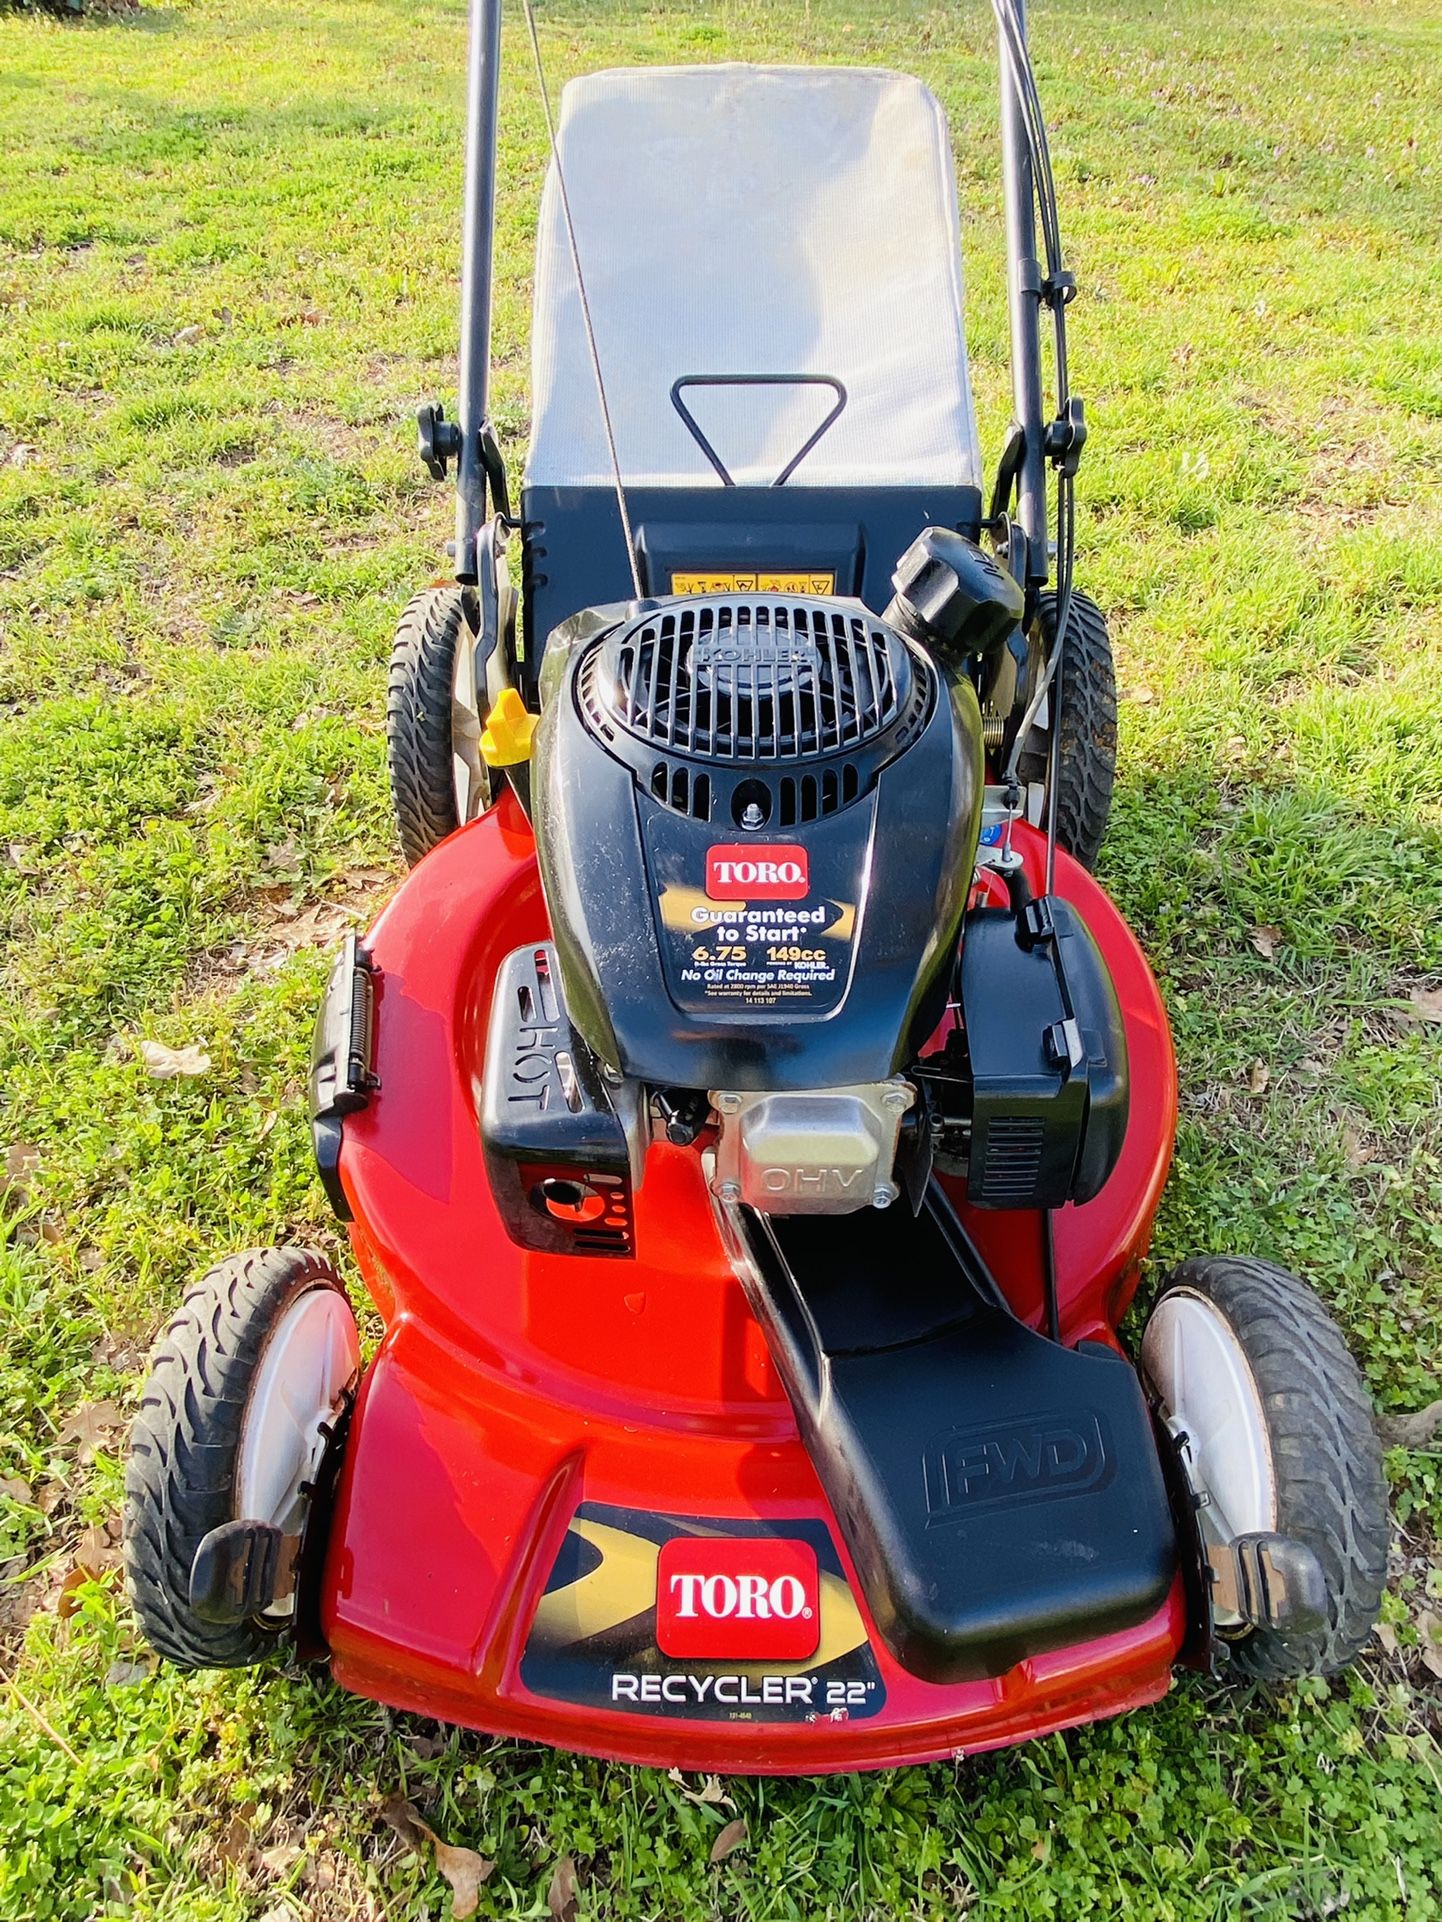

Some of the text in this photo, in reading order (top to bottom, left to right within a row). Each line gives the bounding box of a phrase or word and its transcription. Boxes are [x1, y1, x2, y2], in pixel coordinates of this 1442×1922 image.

[691, 906, 826, 924] Guaranteed
[717, 927, 739, 941] to
[692, 946, 826, 961] 6.75 149cc
[681, 968, 835, 983] No Oil Change Required
[507, 1026, 559, 1111] HOT
[761, 1167, 864, 1193] OHV
[957, 1428, 1087, 1495] FWD
